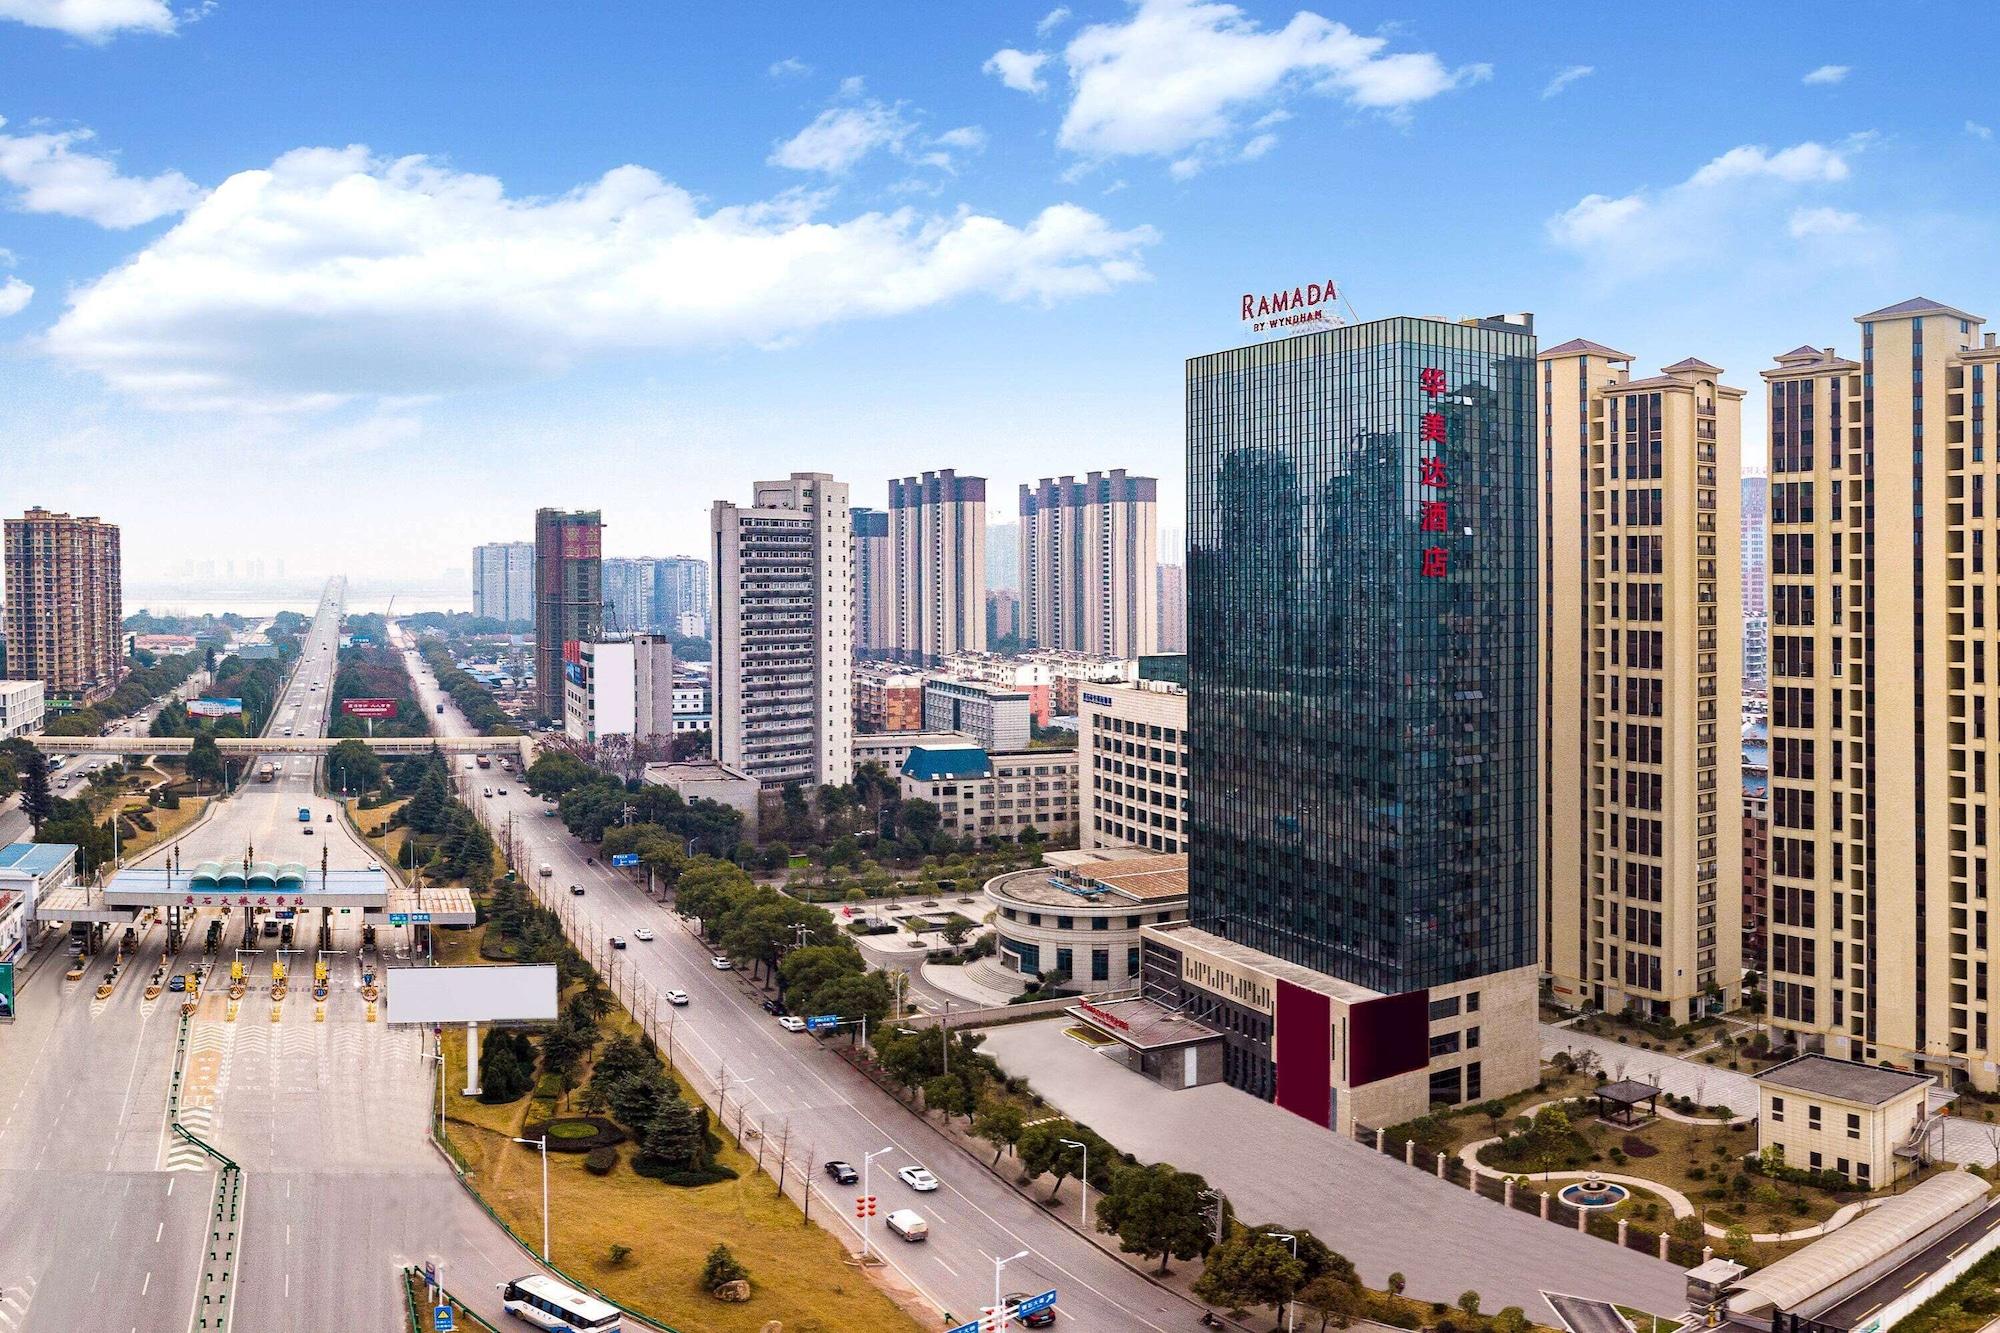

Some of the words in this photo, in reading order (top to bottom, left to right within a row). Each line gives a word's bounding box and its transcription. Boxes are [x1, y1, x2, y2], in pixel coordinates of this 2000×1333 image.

[1242, 279, 1337, 321] RAMADA
[1253, 322, 1266, 333] BY
[1269, 309, 1322, 329] WYNDHAM
[1420, 367, 1448, 577] 华美达酒店
